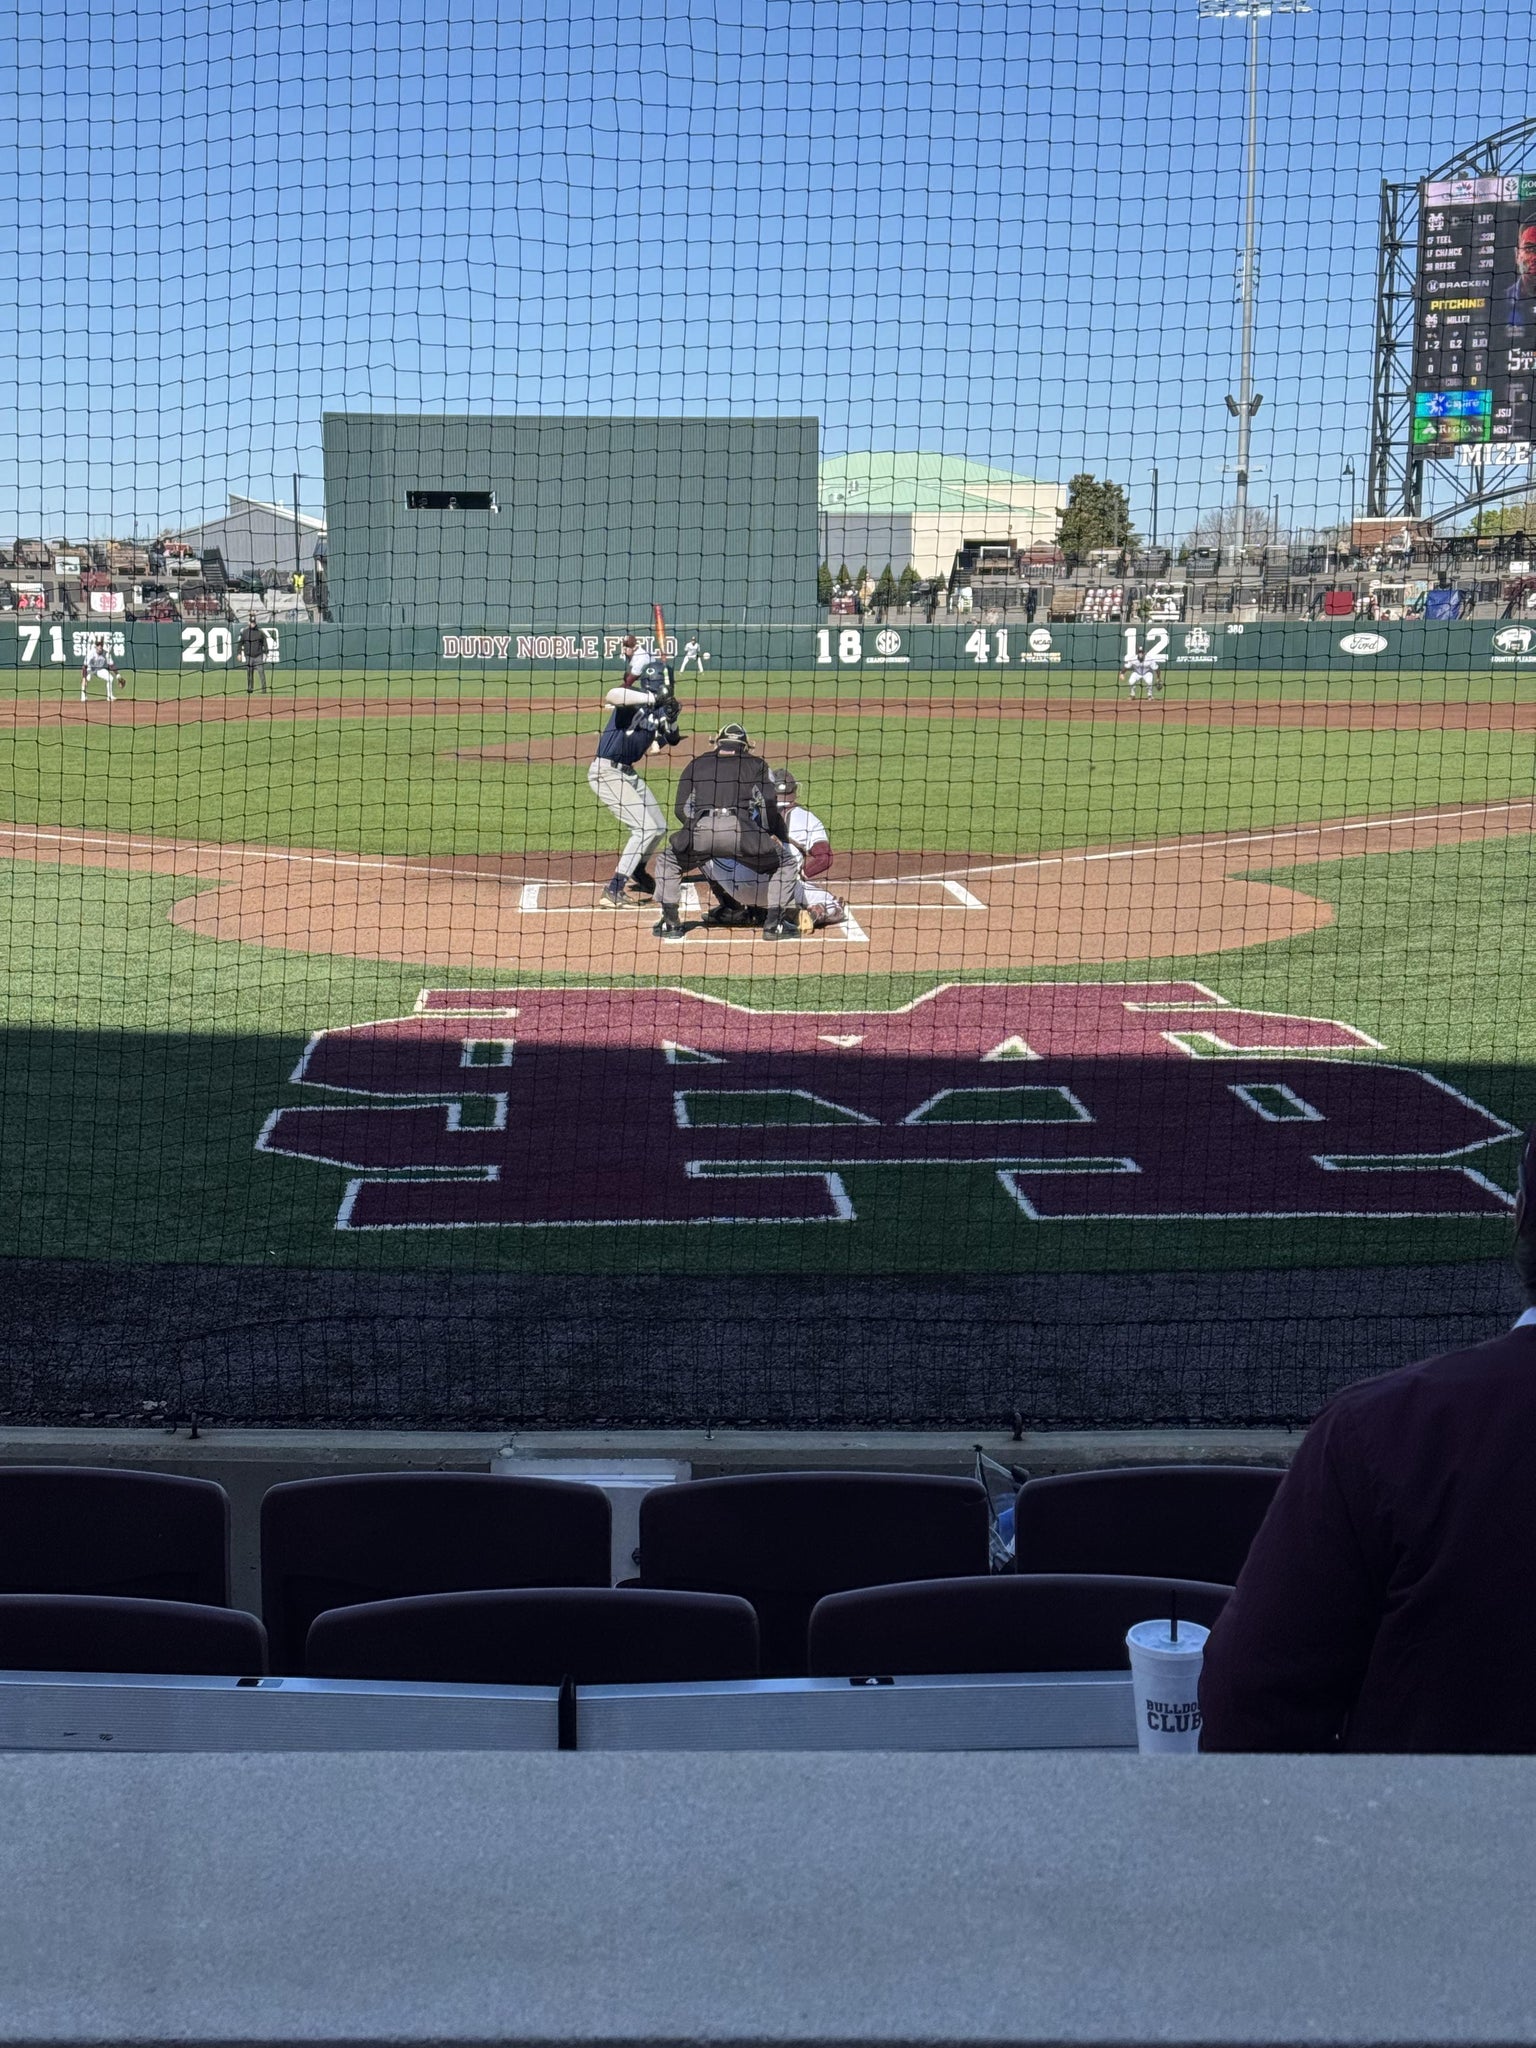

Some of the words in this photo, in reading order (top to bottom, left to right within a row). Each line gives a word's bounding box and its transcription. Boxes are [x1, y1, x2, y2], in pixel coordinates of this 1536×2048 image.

[1439, 280, 1489, 289] BRACKEN
[1431, 298, 1486, 311] PITCHING
[1461, 441, 1530, 466] MIZE
[72, 631, 113, 644] STATE
[1227, 624, 1244, 635] 380
[18, 625, 67, 662] 71
[182, 626, 233, 662] 20
[443, 635, 511, 659] DUDY
[517, 635, 599, 659] NOBLE
[817, 629, 862, 664] 18
[877, 631, 900, 654] SEC
[965, 628, 1010, 663] 41
[1124, 627, 1170, 662] 12
[1350, 636, 1378, 650] Ford
[1146, 1699, 1200, 1714] BULLDO
[1147, 1711, 1201, 1732] CLUB
